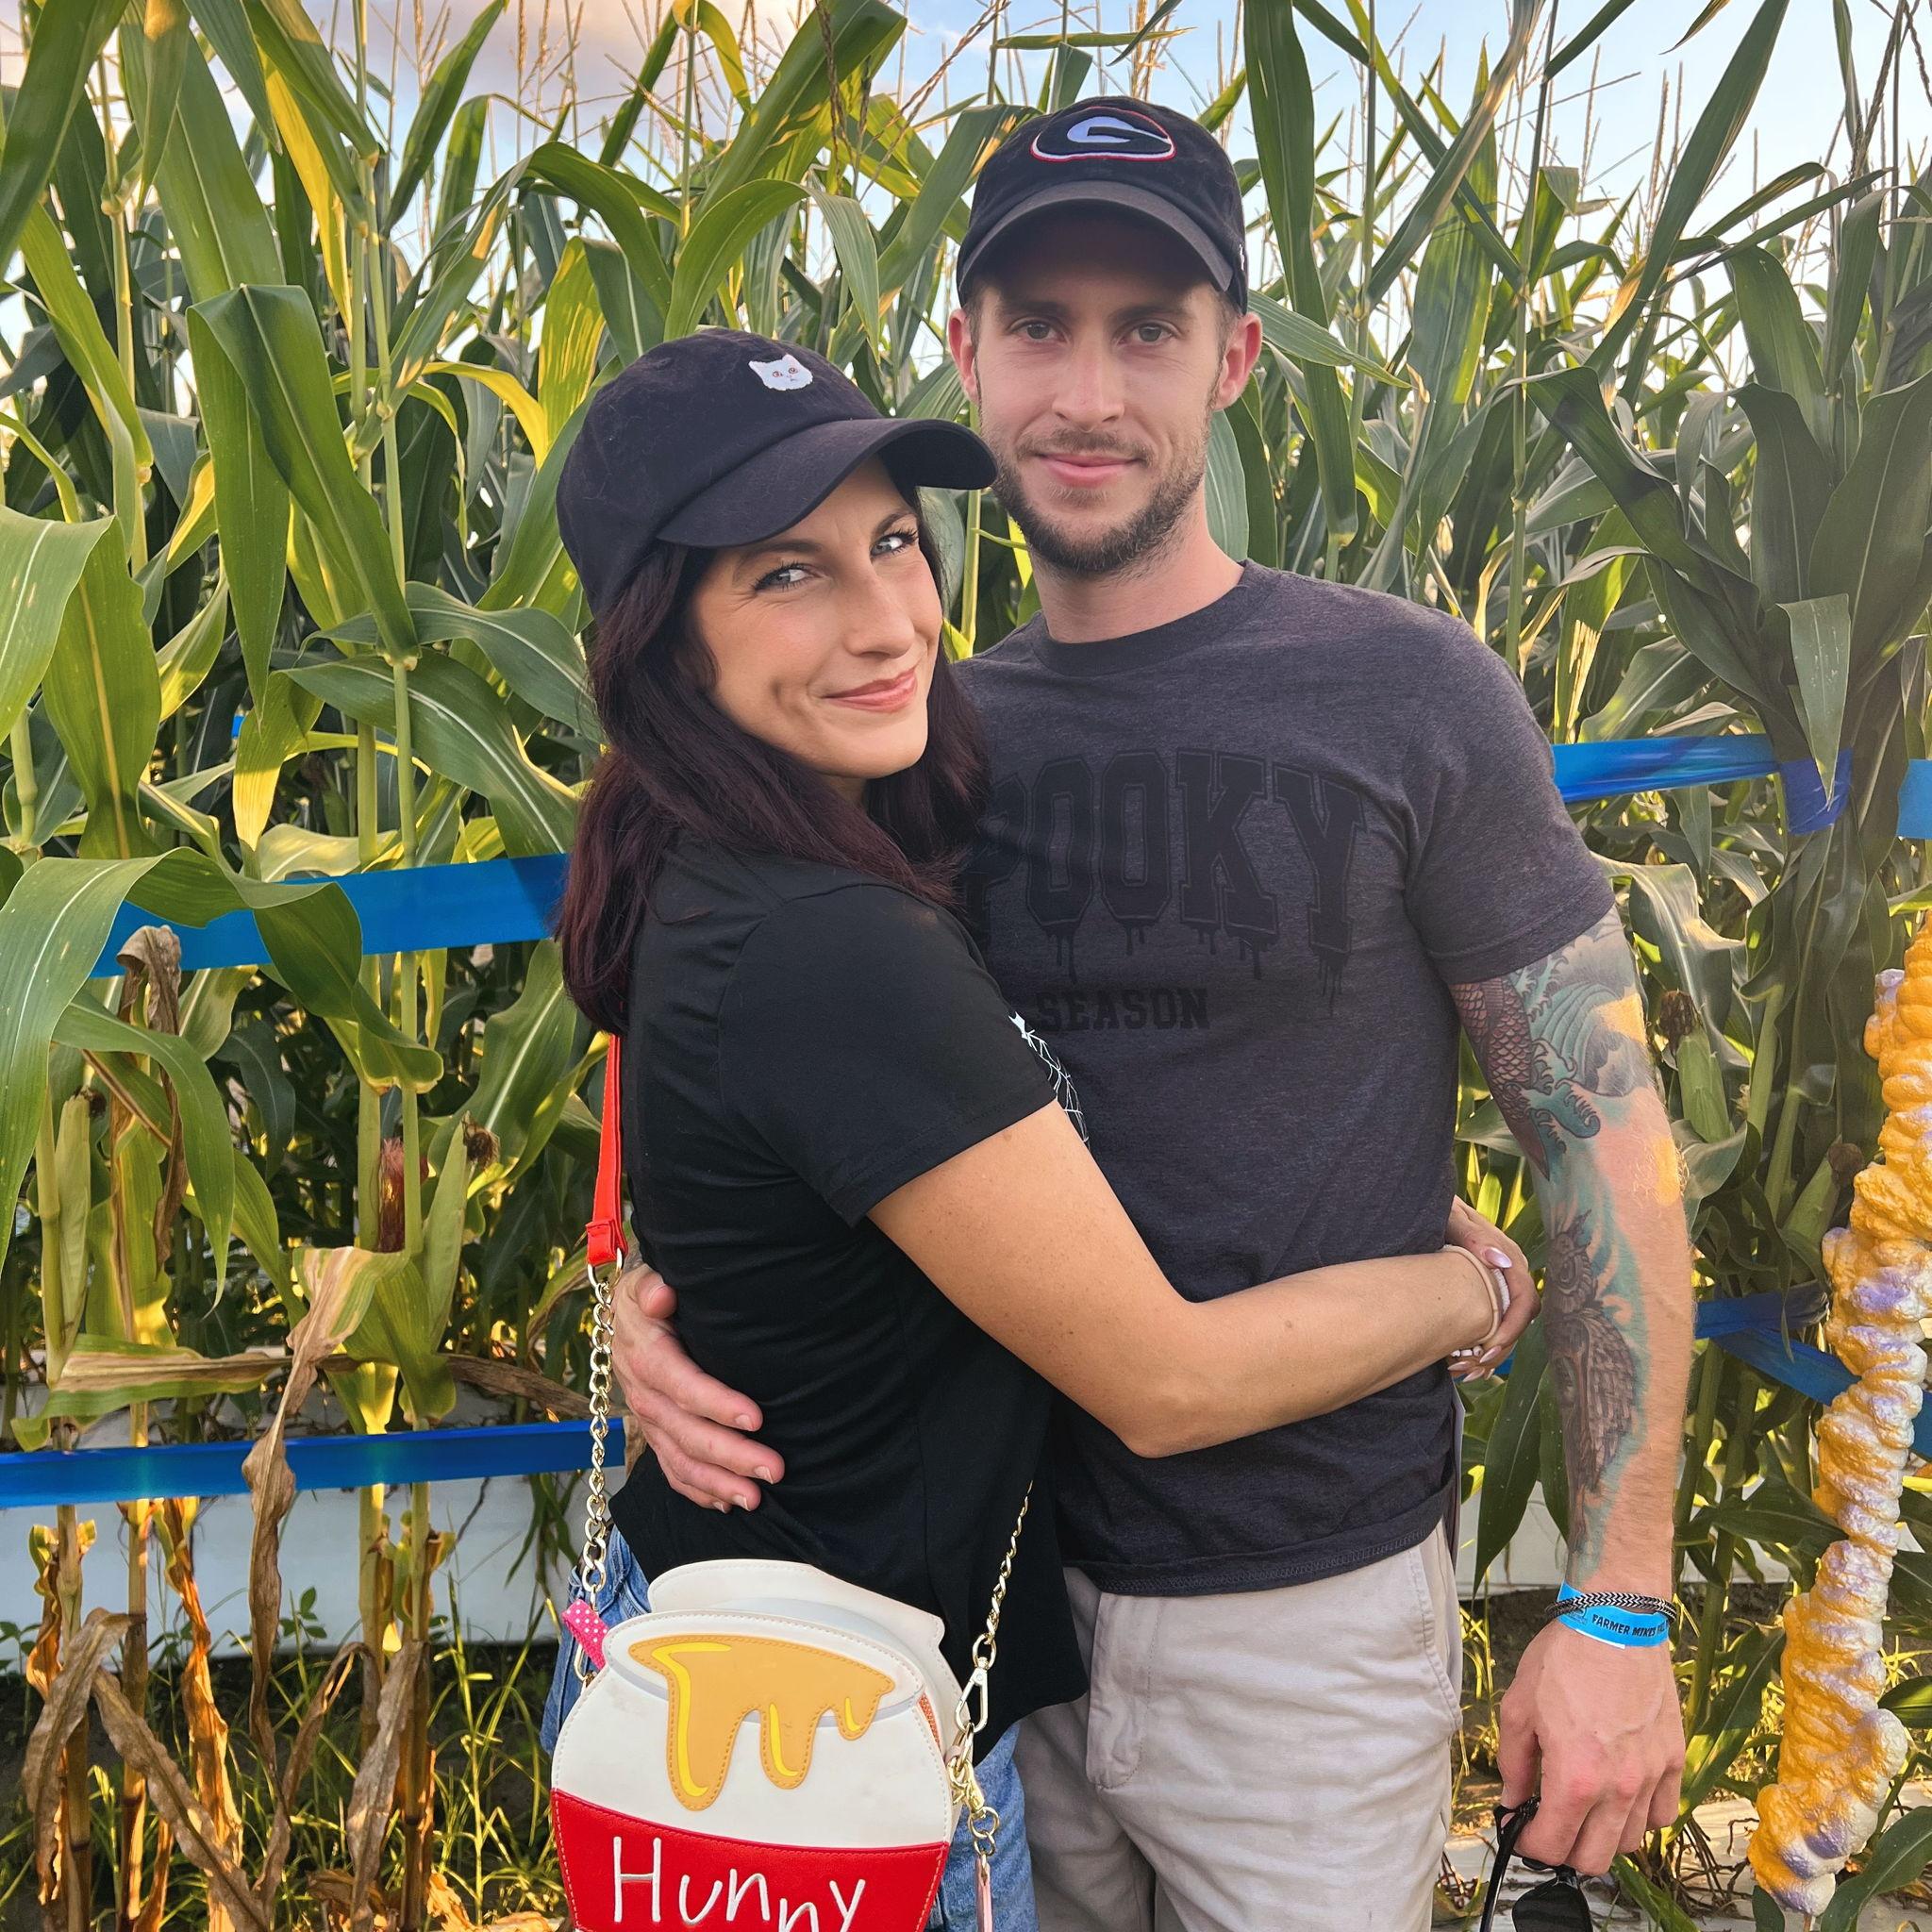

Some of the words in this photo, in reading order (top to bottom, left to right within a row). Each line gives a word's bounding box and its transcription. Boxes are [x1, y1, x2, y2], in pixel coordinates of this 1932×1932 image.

[964, 747, 1368, 955] POOKY
[1037, 987, 1210, 1031] SEASON
[1591, 1613, 1630, 1635] FARMER
[613, 1836, 866, 1932] Hunny
